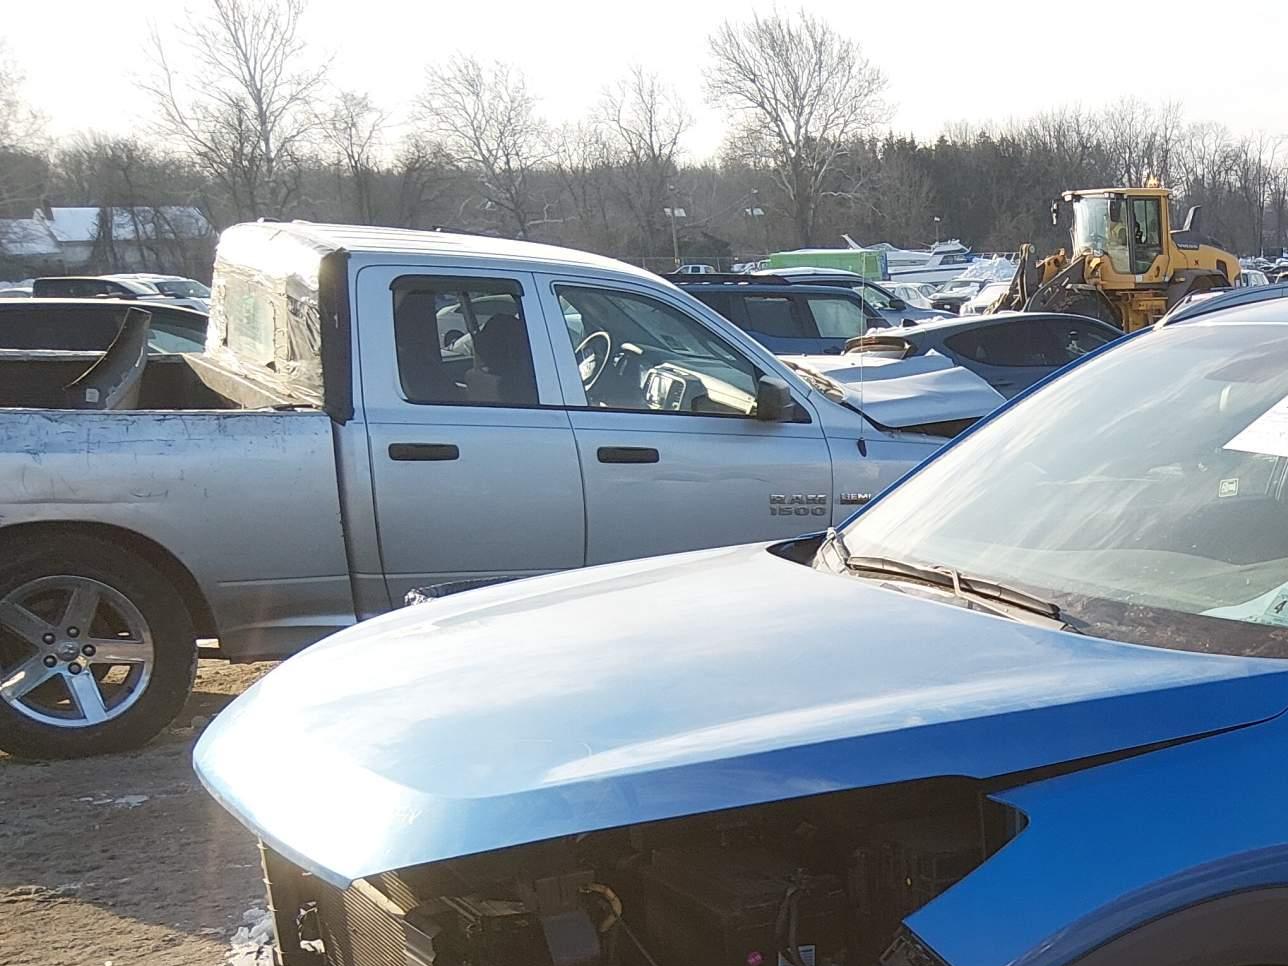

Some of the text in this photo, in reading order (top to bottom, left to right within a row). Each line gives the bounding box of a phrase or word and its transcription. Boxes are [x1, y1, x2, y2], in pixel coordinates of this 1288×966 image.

[769, 493, 827, 505] RAM
[769, 506, 827, 517] 1500
[1274, 599, 1288, 614] 4
